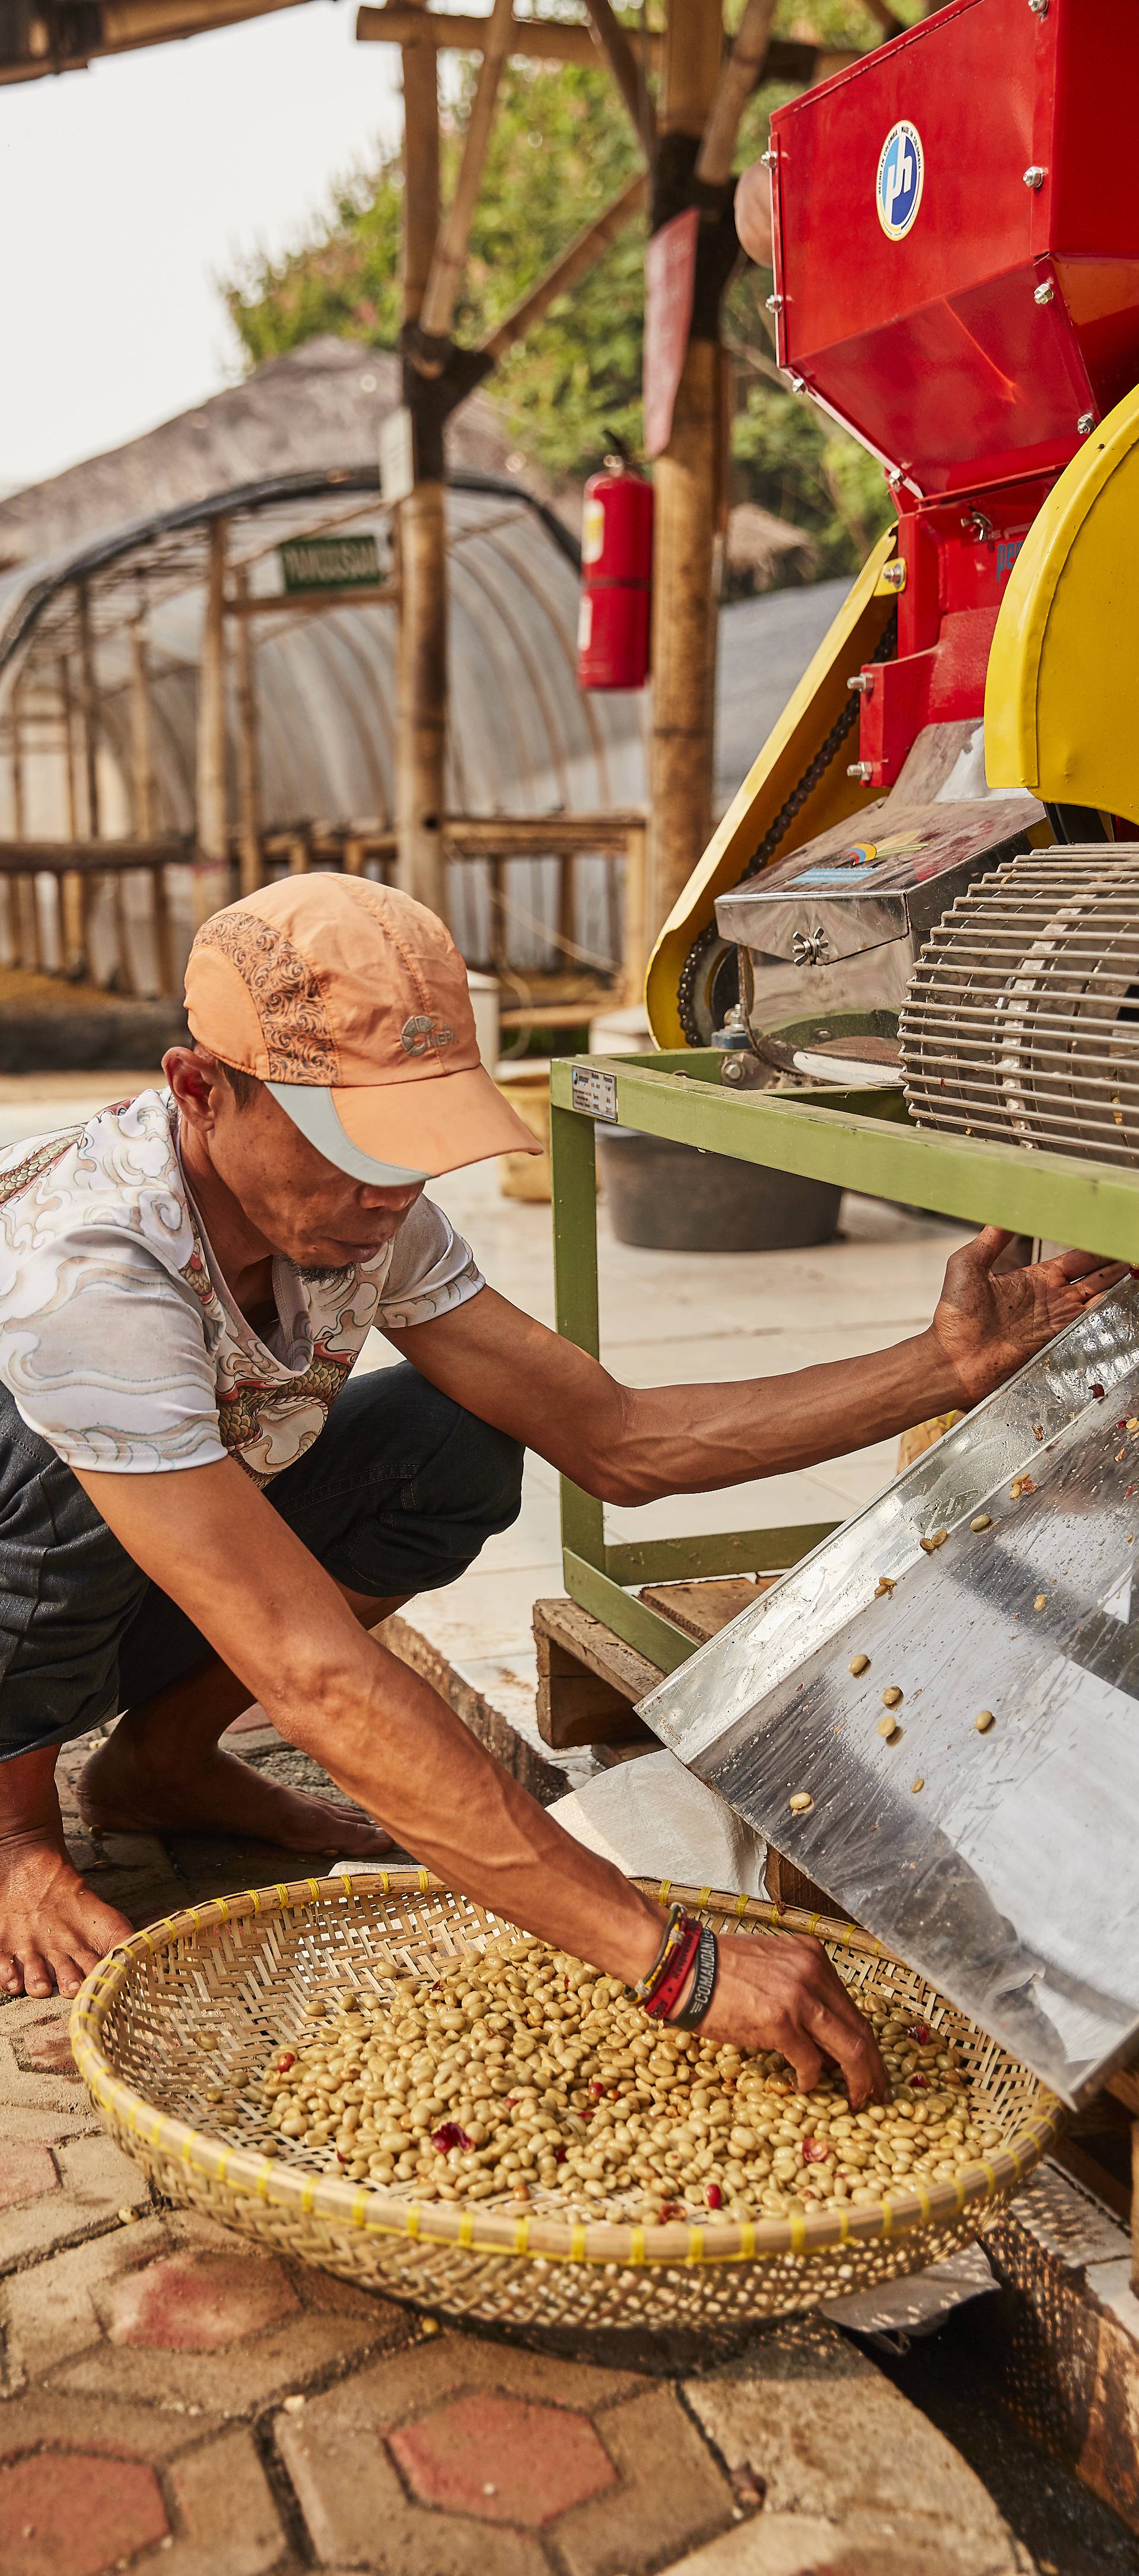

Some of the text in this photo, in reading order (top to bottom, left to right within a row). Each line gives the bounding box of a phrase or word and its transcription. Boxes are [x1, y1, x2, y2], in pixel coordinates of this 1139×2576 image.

[880, 158, 885, 168] EN
[883, 129, 898, 157] COLOMBIA
[901, 126, 921, 170] MADE IN COLOMBIA
[883, 134, 913, 224] ph
